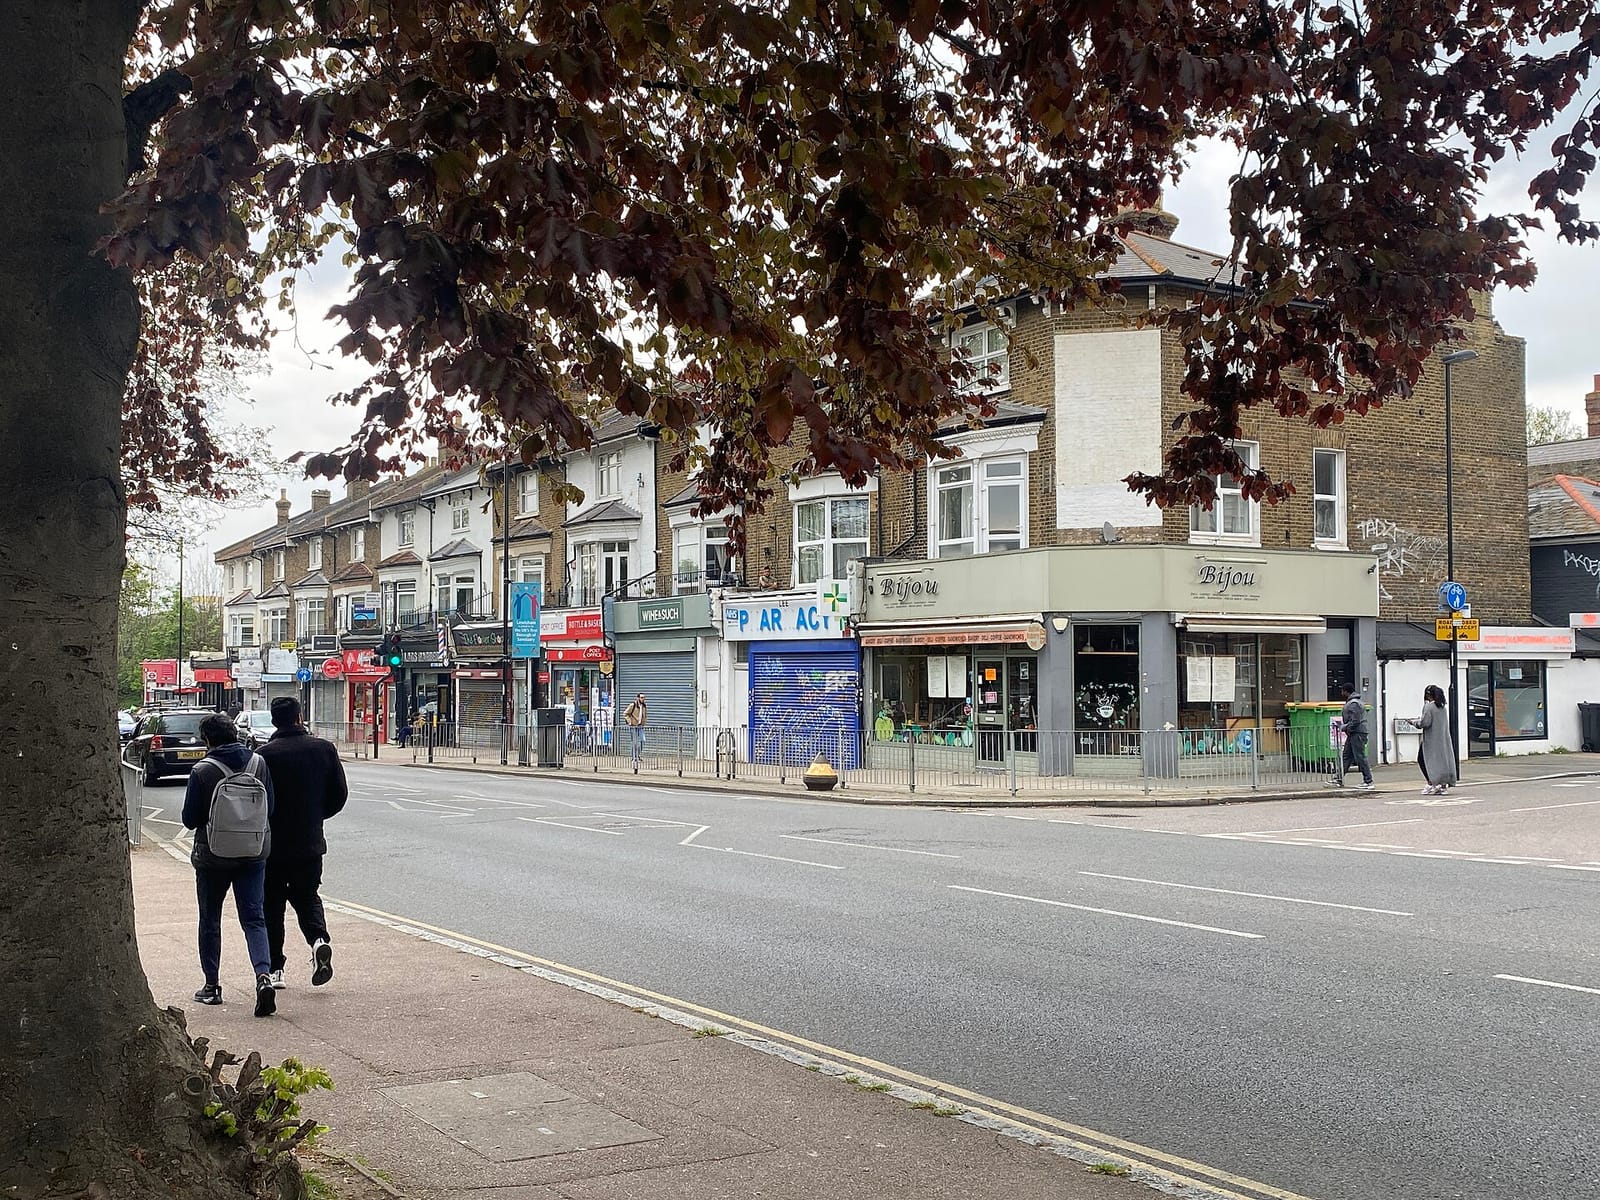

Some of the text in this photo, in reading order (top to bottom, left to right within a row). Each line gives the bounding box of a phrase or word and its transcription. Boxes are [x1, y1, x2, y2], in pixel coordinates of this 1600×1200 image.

[880, 576, 939, 601] Bijou
[1199, 565, 1256, 593] Bijou
[588, 618, 601, 627] BASKE
